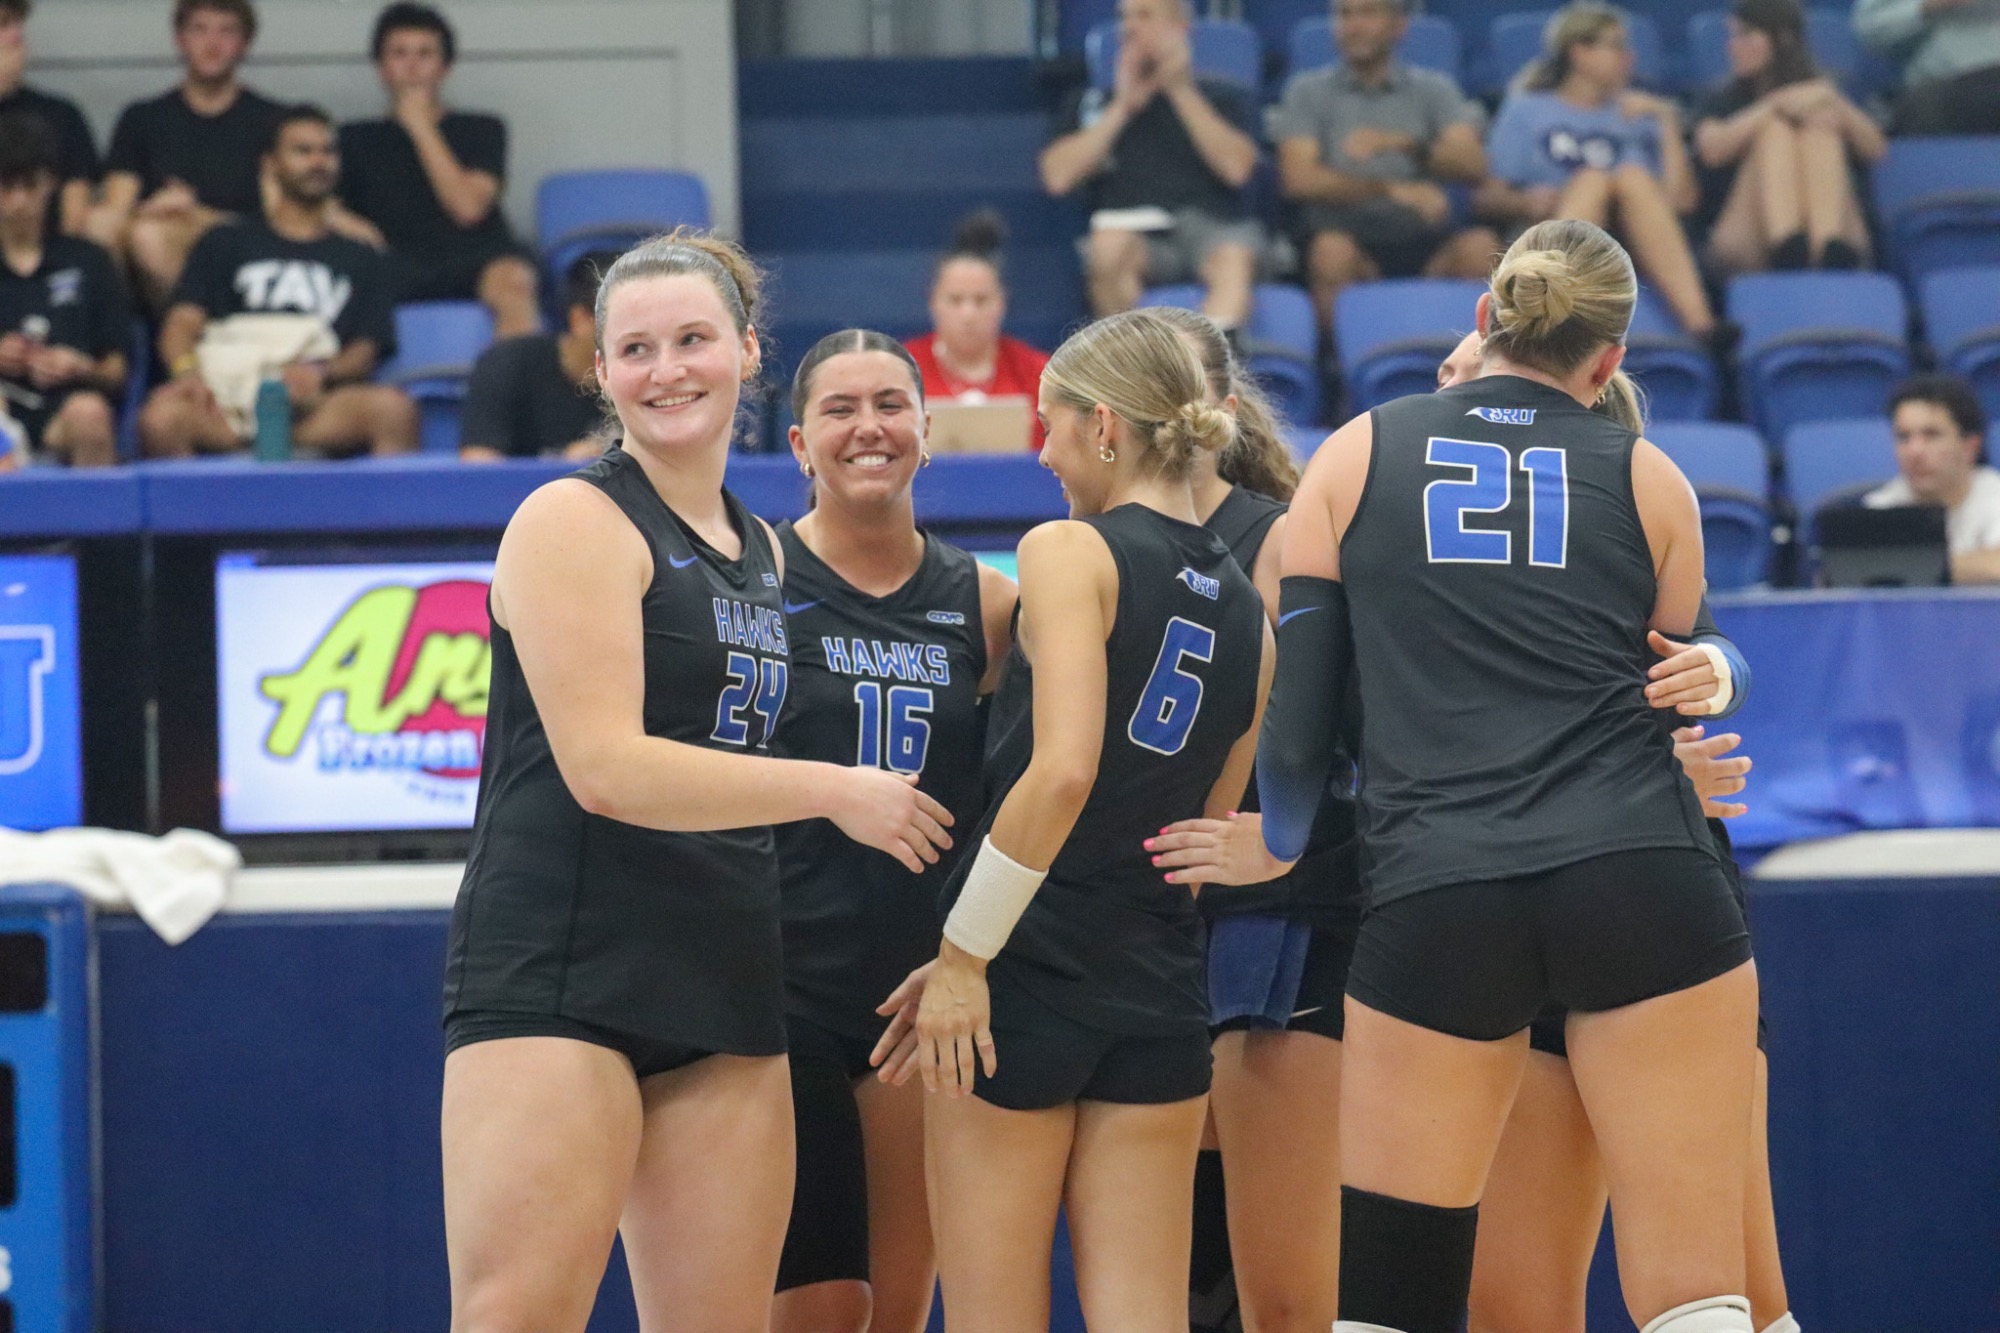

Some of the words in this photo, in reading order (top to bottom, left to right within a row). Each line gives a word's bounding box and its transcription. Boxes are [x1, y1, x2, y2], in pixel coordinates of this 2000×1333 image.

[1423, 436, 1569, 569] 21
[713, 597, 788, 656] HAWKS
[821, 636, 950, 686] HAWKS
[709, 650, 788, 749] 24
[854, 681, 934, 774] 16
[1127, 615, 1216, 756] 6
